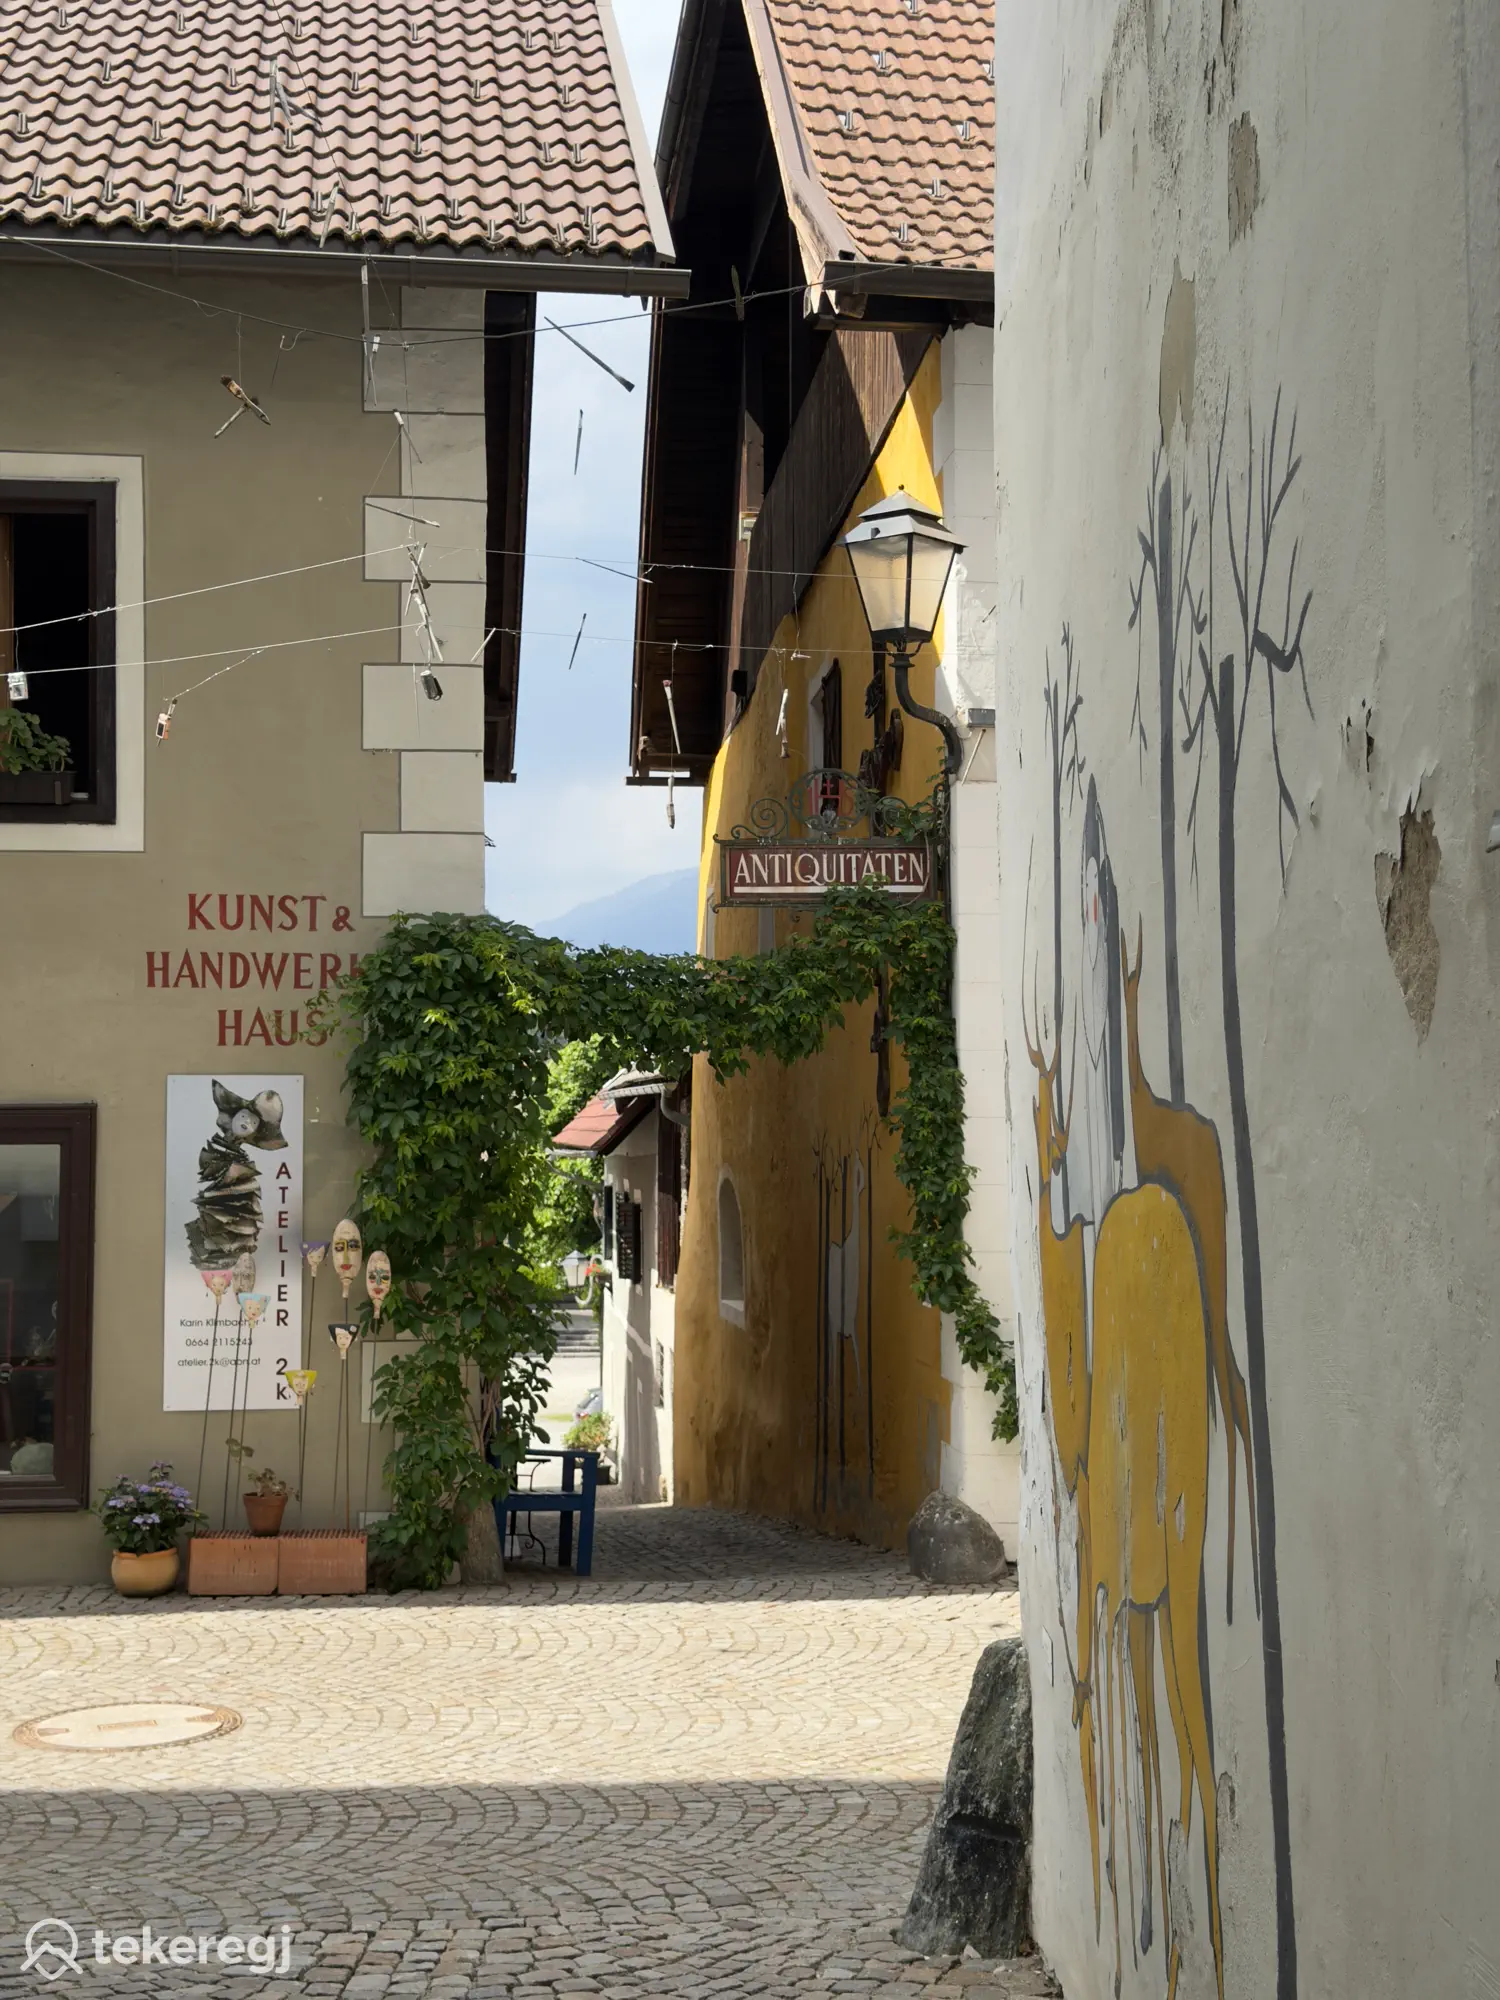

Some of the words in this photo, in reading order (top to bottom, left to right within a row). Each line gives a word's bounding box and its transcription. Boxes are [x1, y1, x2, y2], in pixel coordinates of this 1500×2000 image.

[734, 850, 925, 886] ANTIQUITÄTEN
[187, 893, 328, 933] KUNST
[331, 905, 356, 932] &
[217, 1006, 328, 1047] HAUS
[275, 1162, 292, 1327] ATELIER
[180, 1318, 203, 1327] Karin
[206, 1318, 259, 1327] Klmbachr
[185, 1338, 209, 1347] 0664
